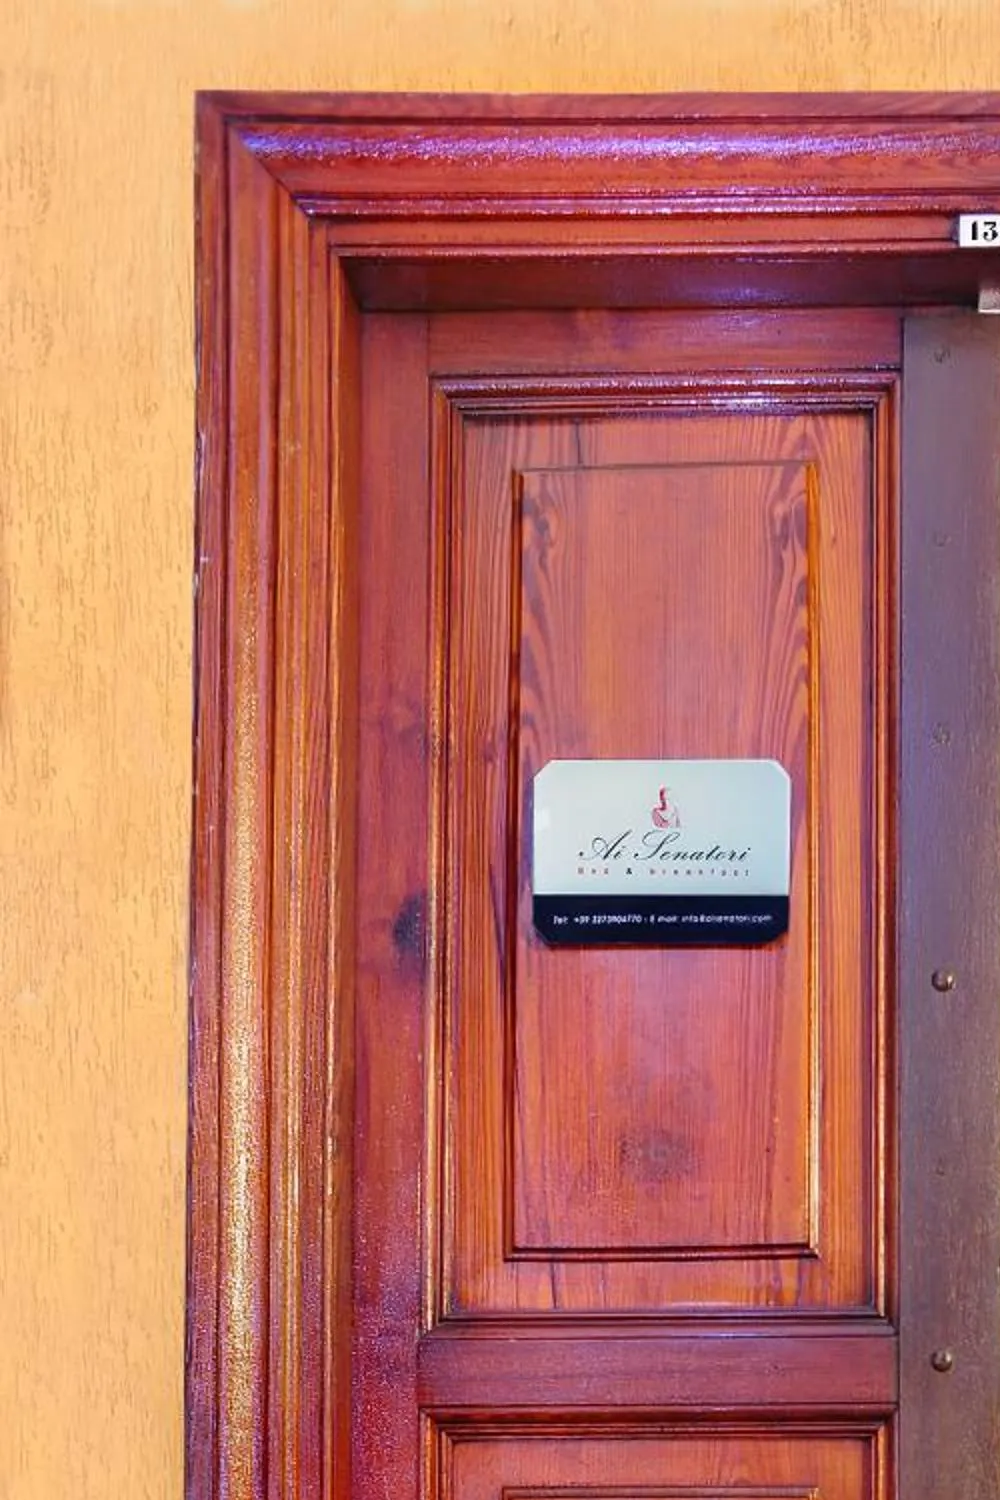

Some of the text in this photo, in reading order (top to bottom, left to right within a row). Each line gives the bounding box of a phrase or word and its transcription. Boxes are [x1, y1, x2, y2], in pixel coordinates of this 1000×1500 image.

[971, 220, 998, 242] 13
[577, 829, 751, 861] Ai Senatori
